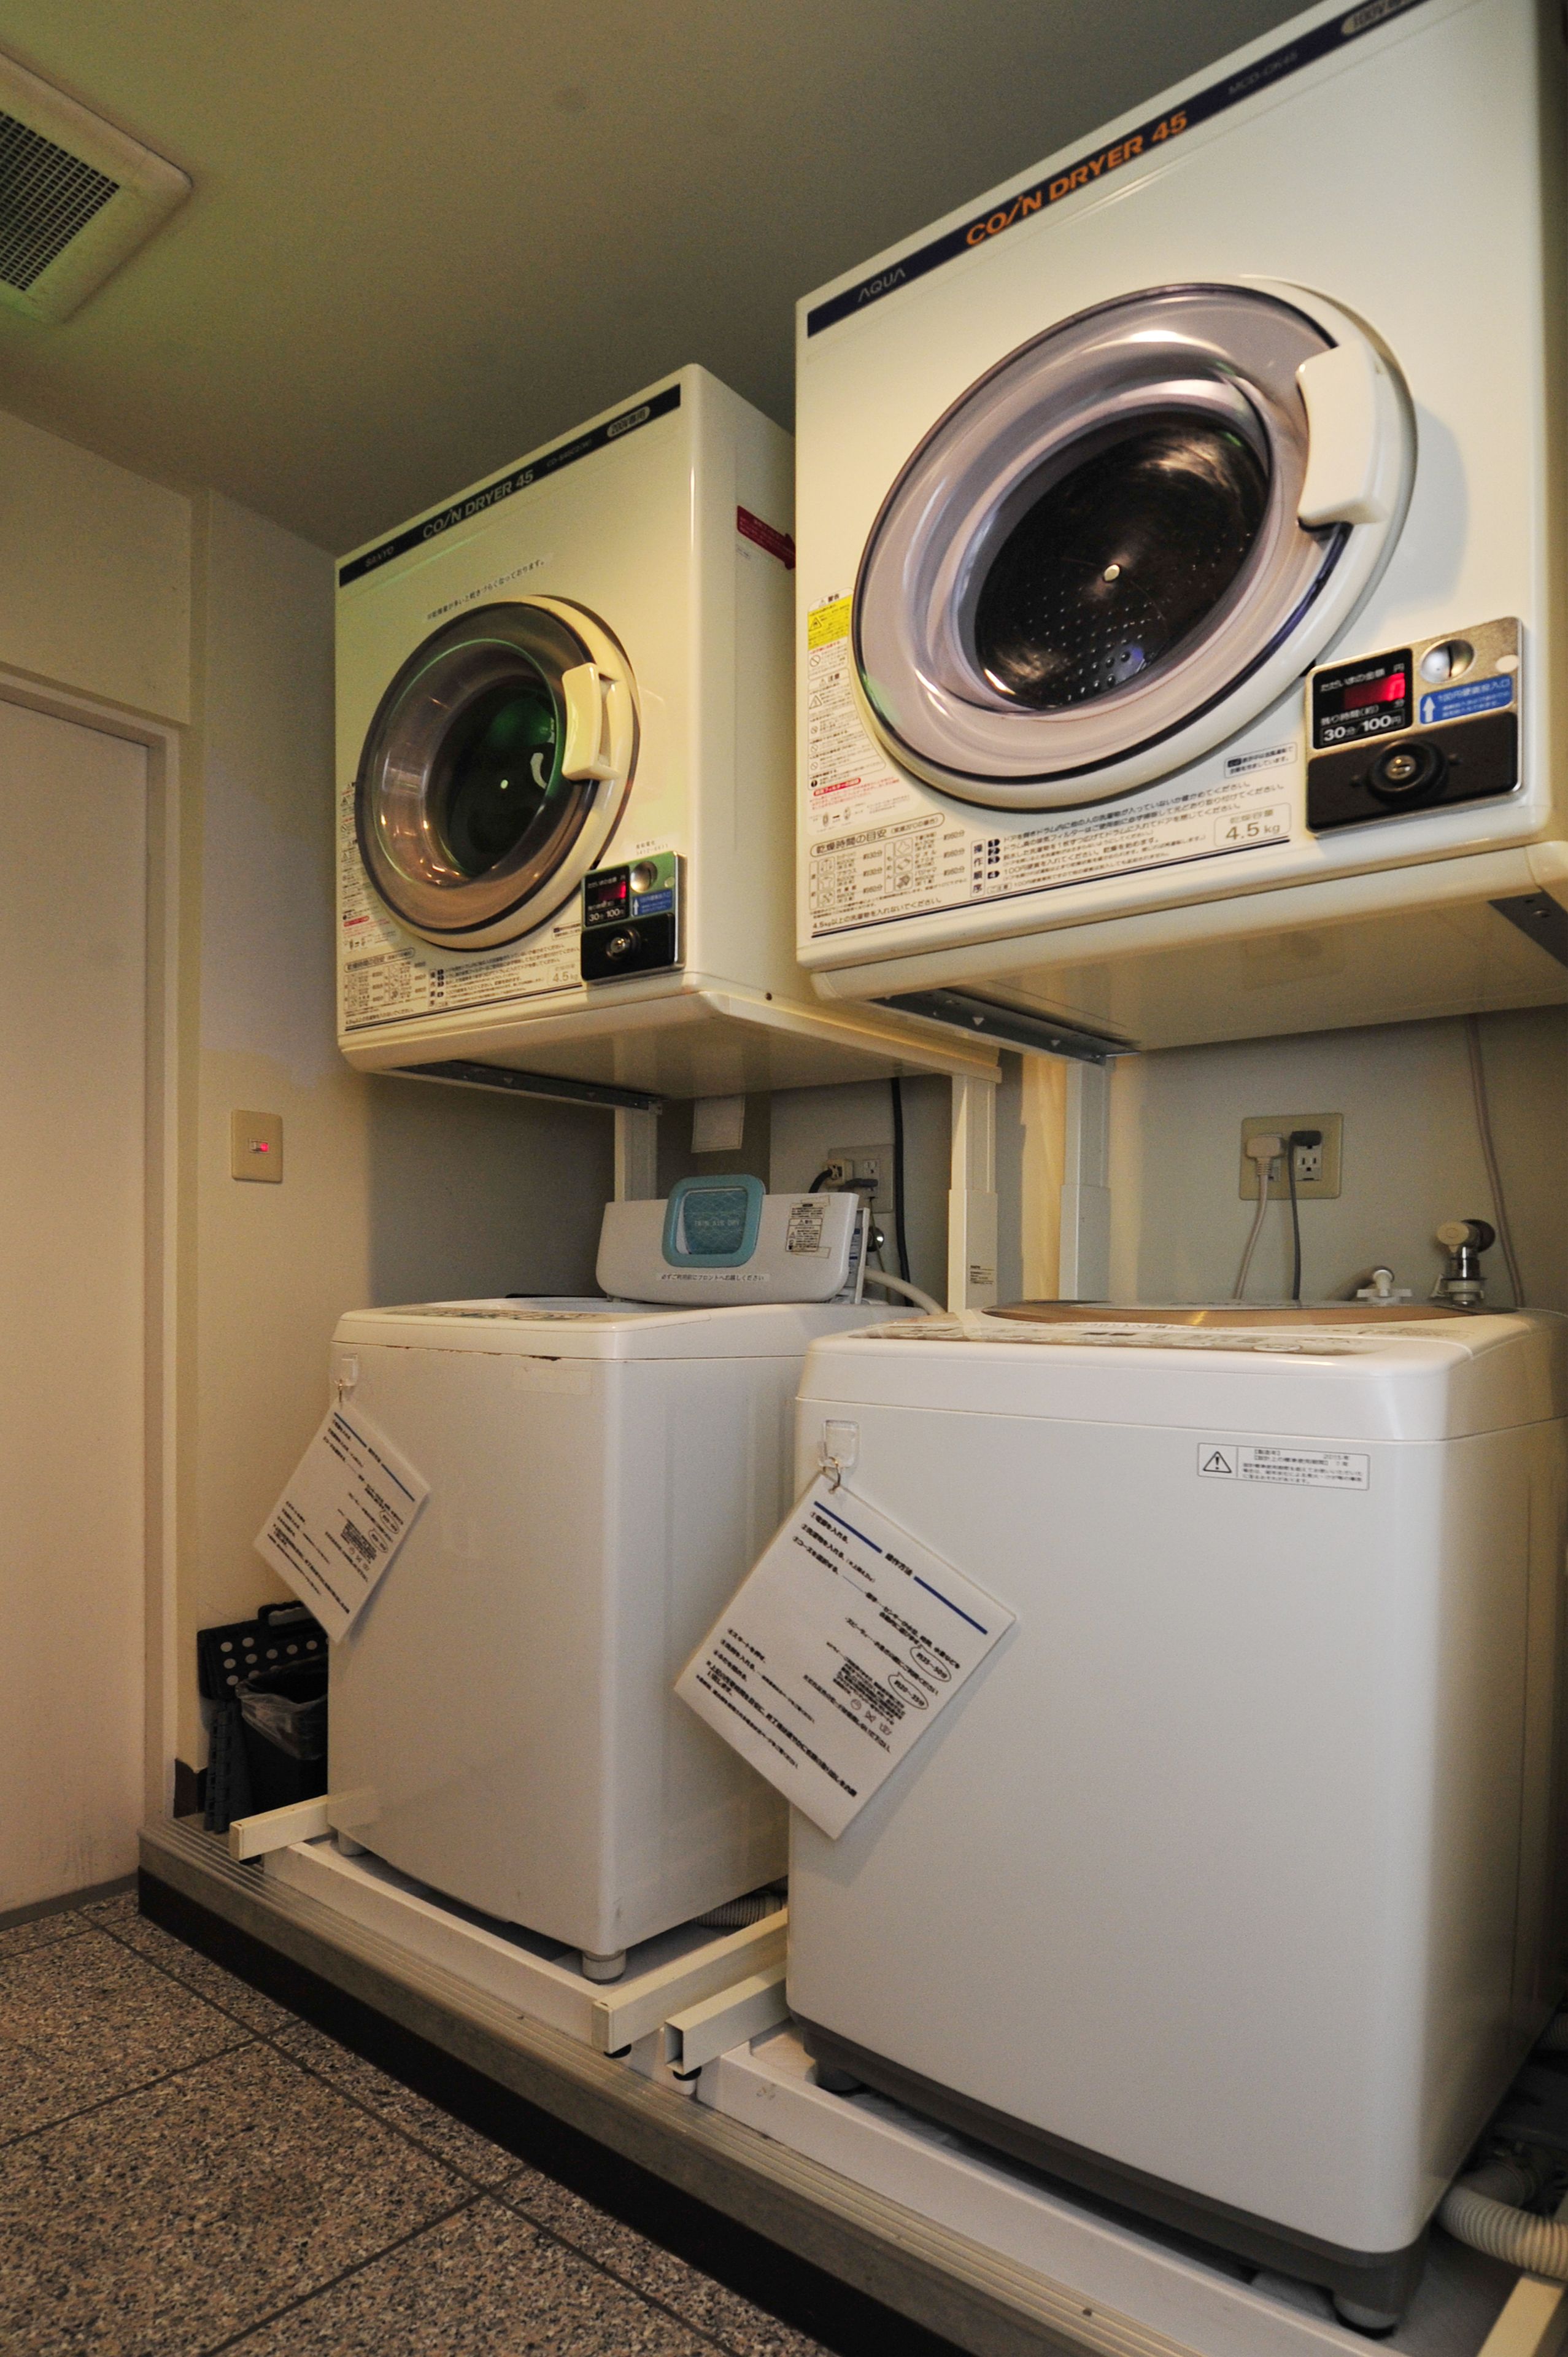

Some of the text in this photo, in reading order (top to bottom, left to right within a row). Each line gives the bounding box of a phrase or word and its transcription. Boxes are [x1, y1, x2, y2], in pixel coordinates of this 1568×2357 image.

[859, 268, 905, 302] AQUA
[1049, 136, 1143, 200] DRYER
[1151, 111, 1188, 143] 45
[465, 481, 513, 516] DRYER
[516, 469, 534, 487] 45
[1226, 822, 1281, 841] 4.5 kg
[552, 970, 570, 983] 4.5
